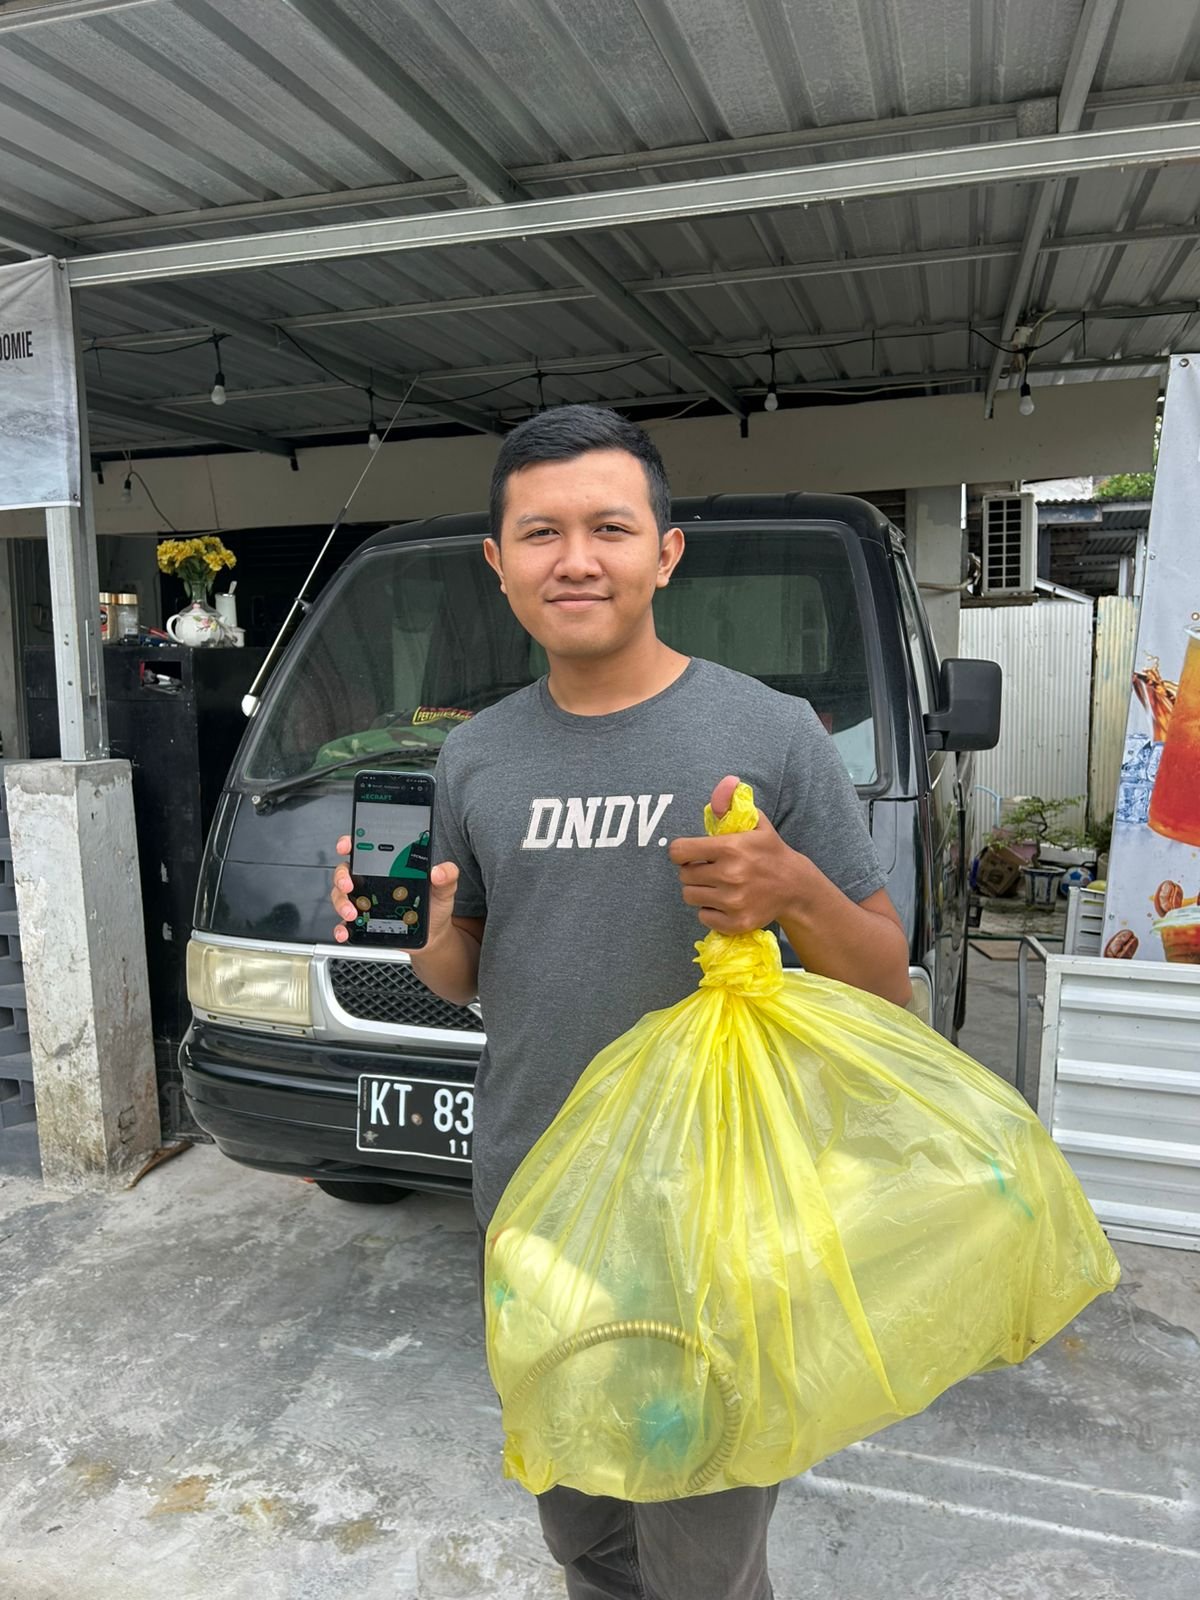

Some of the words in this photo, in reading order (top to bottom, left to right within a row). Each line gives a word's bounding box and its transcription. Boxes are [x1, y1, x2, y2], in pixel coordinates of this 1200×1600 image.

[0, 331, 33, 361] OMIE
[520, 794, 674, 850] DNDV.
[370, 1081, 413, 1127] KT
[433, 1088, 474, 1135] 83
[449, 1138, 468, 1156] 11
